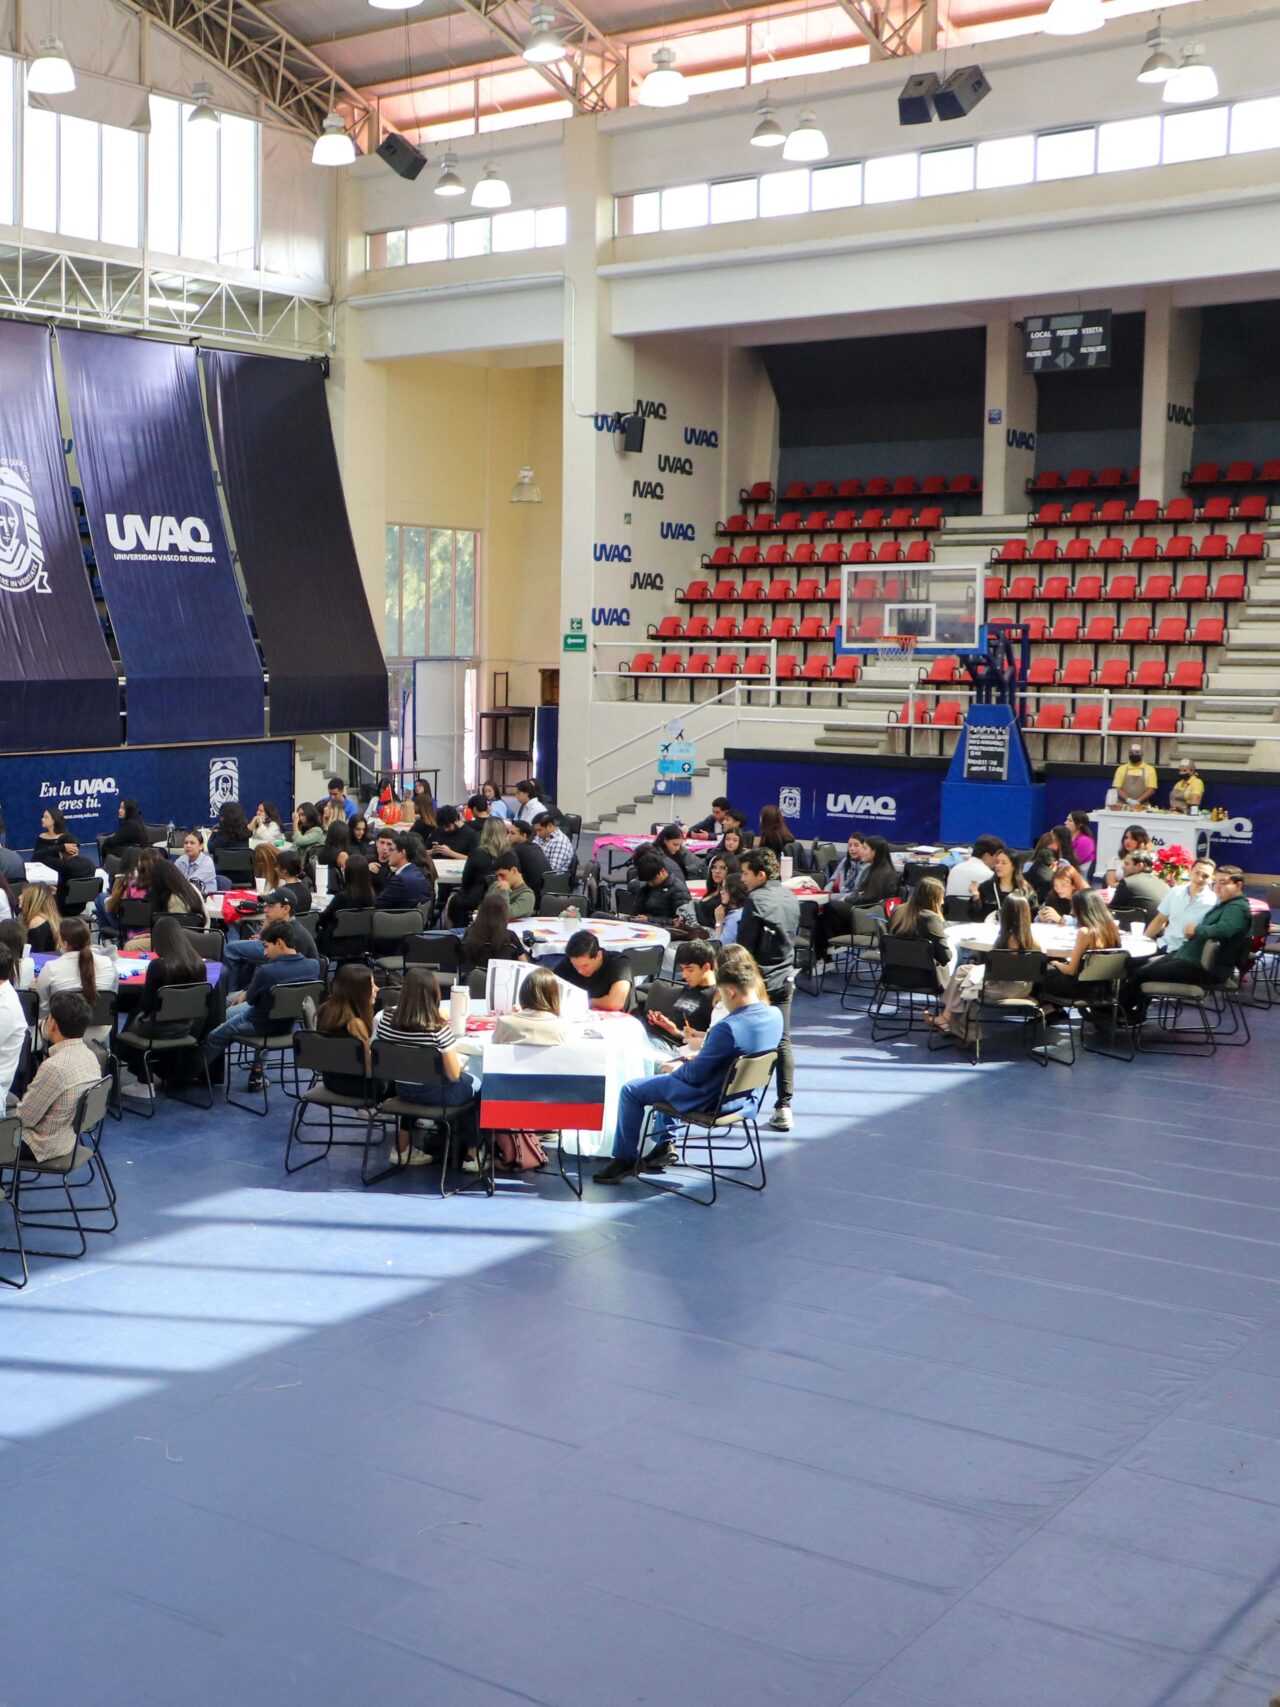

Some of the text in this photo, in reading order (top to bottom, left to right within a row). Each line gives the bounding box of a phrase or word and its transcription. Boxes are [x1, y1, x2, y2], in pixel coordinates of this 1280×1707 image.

[1030, 330, 1052, 339] LOCAL
[1081, 326, 1103, 334] VISITA
[684, 426, 718, 448] UVAQ
[1007, 428, 1034, 451] UVAQ
[657, 454, 693, 475] UVAQ
[104, 513, 213, 553] UVAQ
[660, 521, 695, 541] UVAQ
[114, 553, 157, 561] UNIVERSIDAD
[158, 554, 179, 562] VASCO
[593, 543, 631, 562] UVAQ
[17, 563, 39, 587] VERITATE
[590, 607, 630, 626] UVAQ
[39, 777, 119, 797] En la UVAQ,
[58, 794, 101, 810] eres tú.
[826, 793, 896, 815] UVAQ
